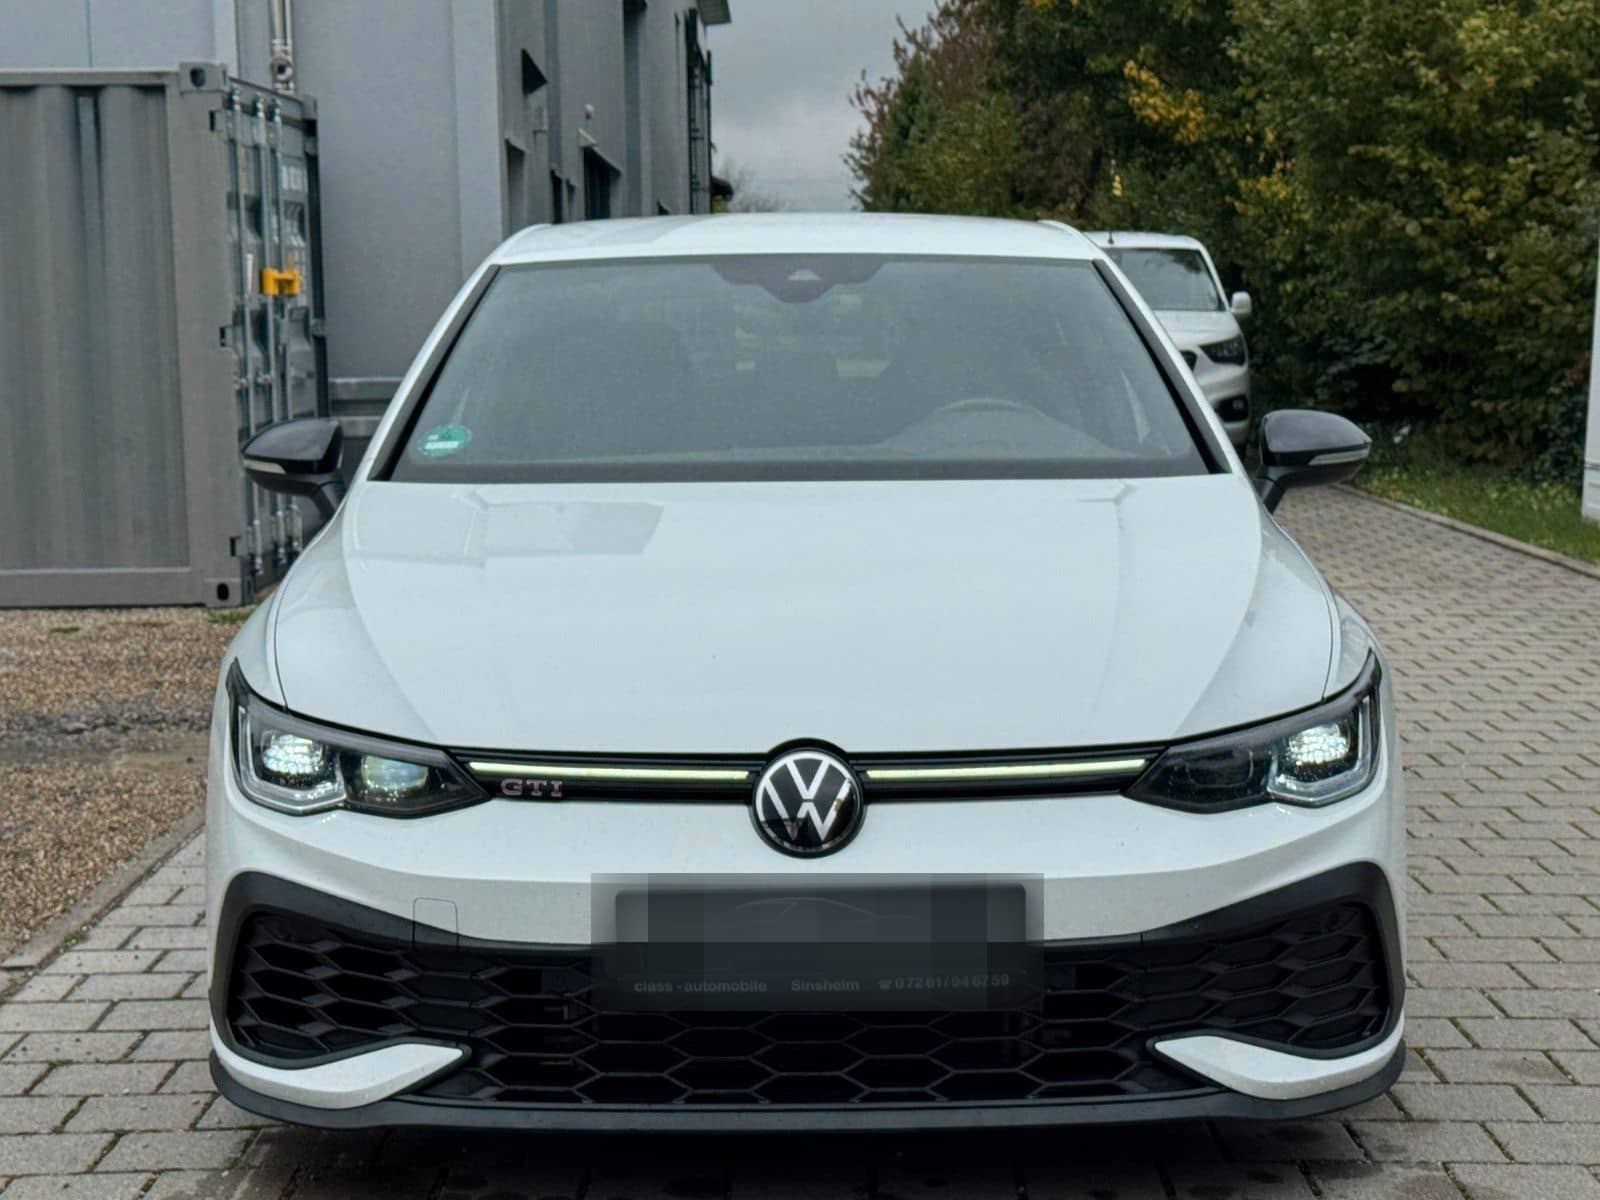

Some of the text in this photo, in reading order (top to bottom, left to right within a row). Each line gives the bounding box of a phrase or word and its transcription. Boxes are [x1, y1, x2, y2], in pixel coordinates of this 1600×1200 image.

[501, 778, 563, 797] GTI
[758, 752, 856, 849] VW
[791, 977, 861, 992] Sinsheim
